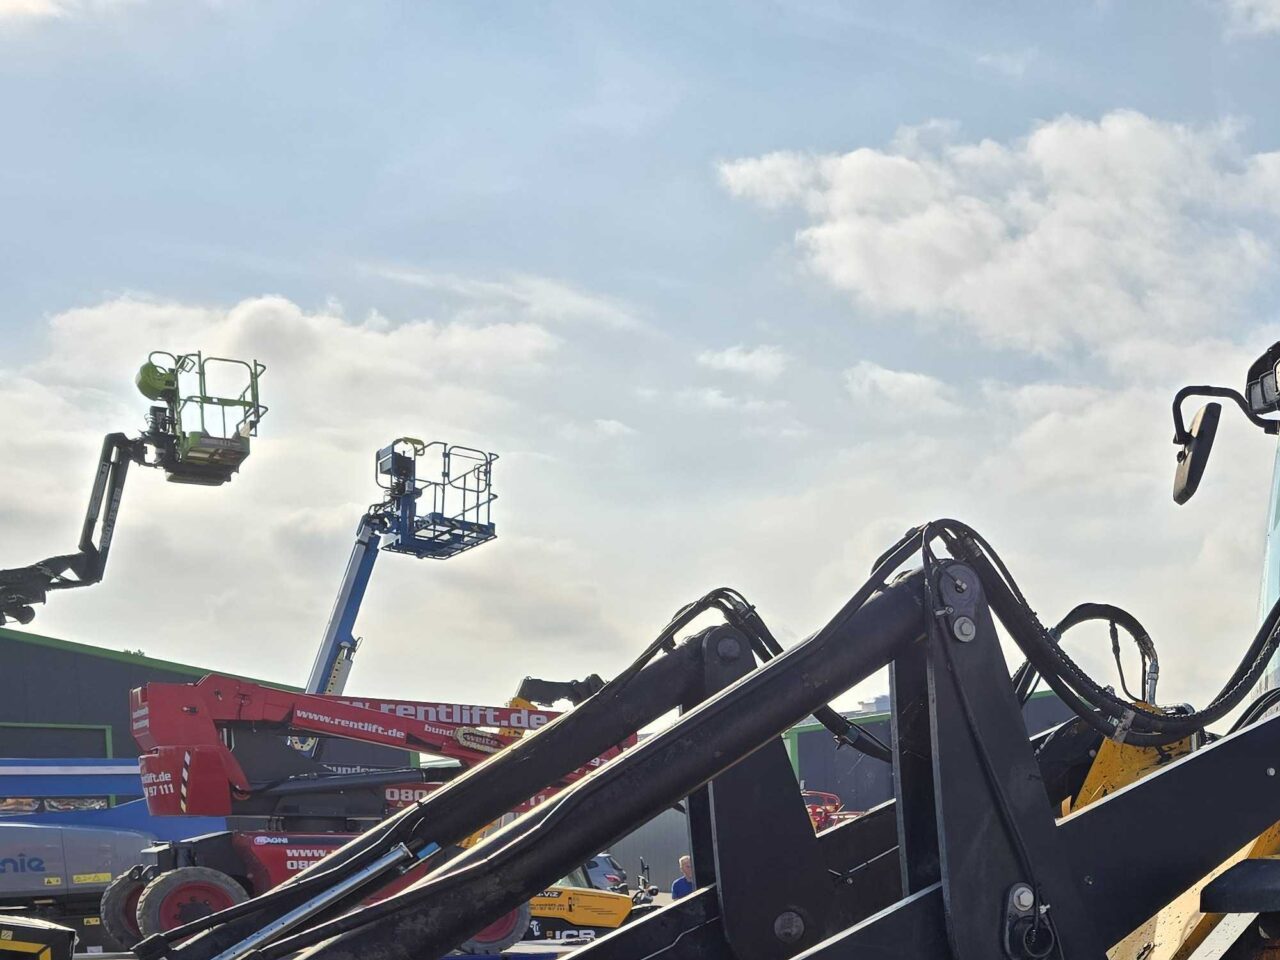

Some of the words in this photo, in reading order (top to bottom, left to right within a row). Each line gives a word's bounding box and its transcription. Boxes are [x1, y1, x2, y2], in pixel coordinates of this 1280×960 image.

[296, 709, 406, 740] www.rentlift.de
[350, 702, 548, 729] rentlift.de
[385, 788, 431, 801] 080
[0, 853, 46, 873] nie
